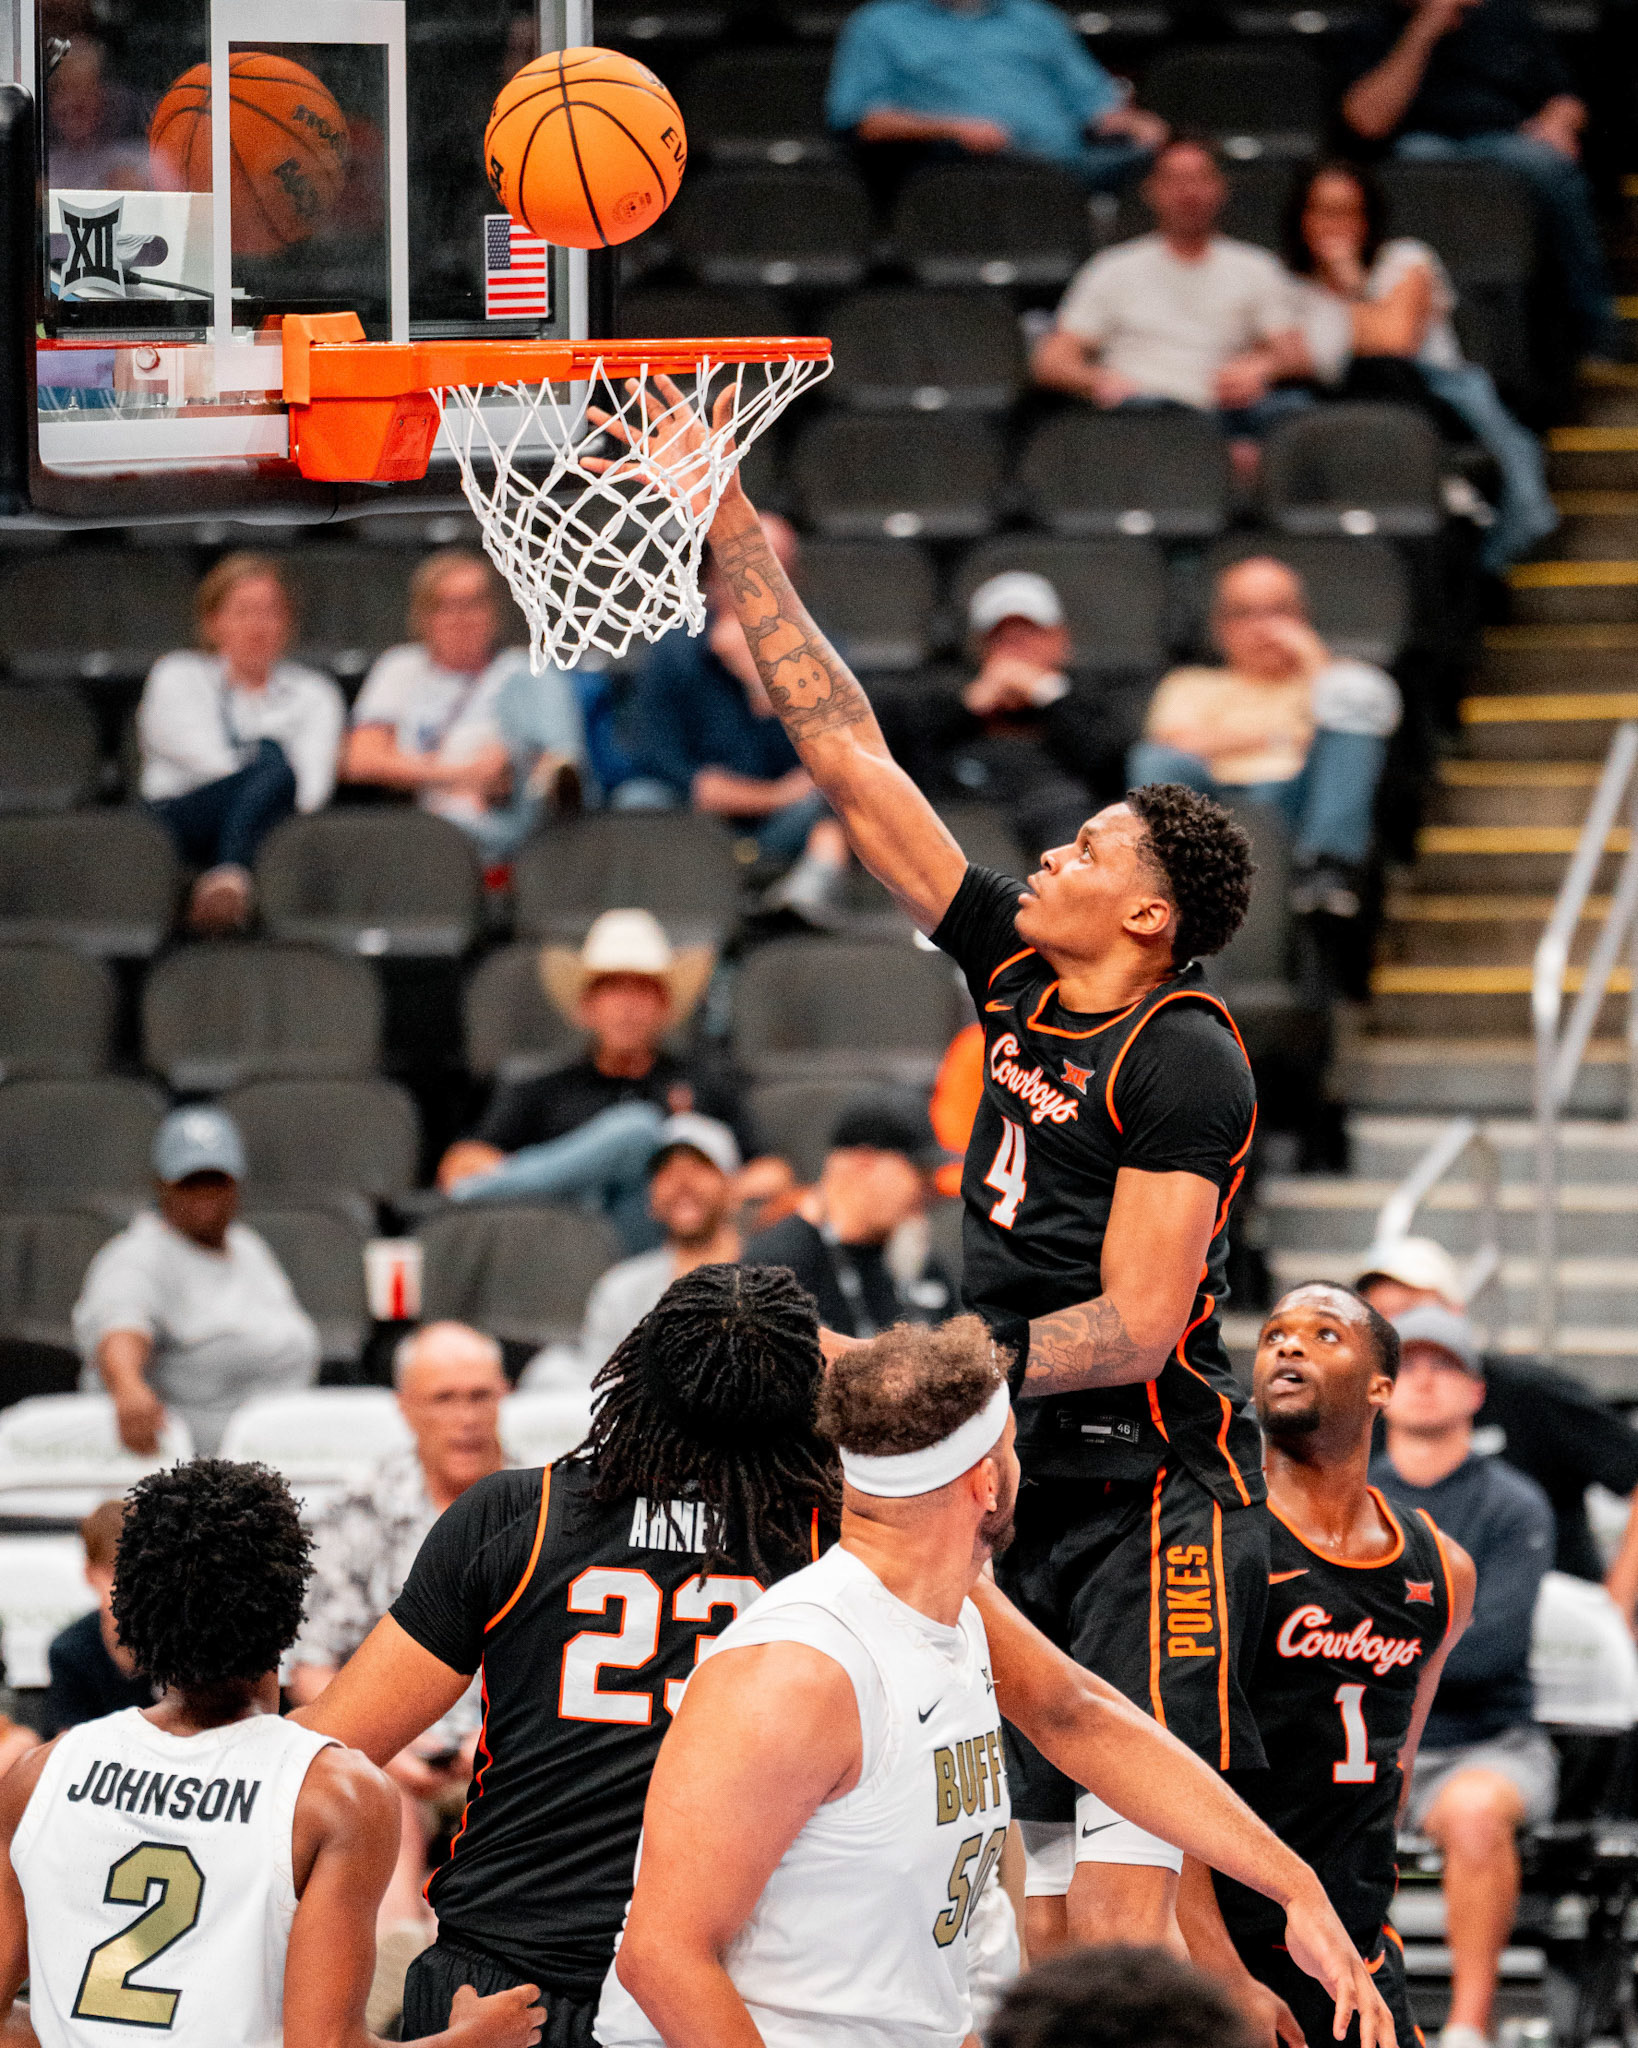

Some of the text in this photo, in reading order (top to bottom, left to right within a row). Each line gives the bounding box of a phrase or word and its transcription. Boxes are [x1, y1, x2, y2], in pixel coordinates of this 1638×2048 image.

[990, 1032, 1079, 1125] Cowboys
[983, 1115, 1027, 1231] 4
[1116, 1422, 1132, 1436] 46
[1165, 1544, 1217, 1659] POKES
[1276, 1603, 1423, 1677] Cowboys
[1332, 1682, 1378, 1784] 1
[67, 1760, 262, 1825] JOHNSON
[70, 1840, 206, 2030] 2
